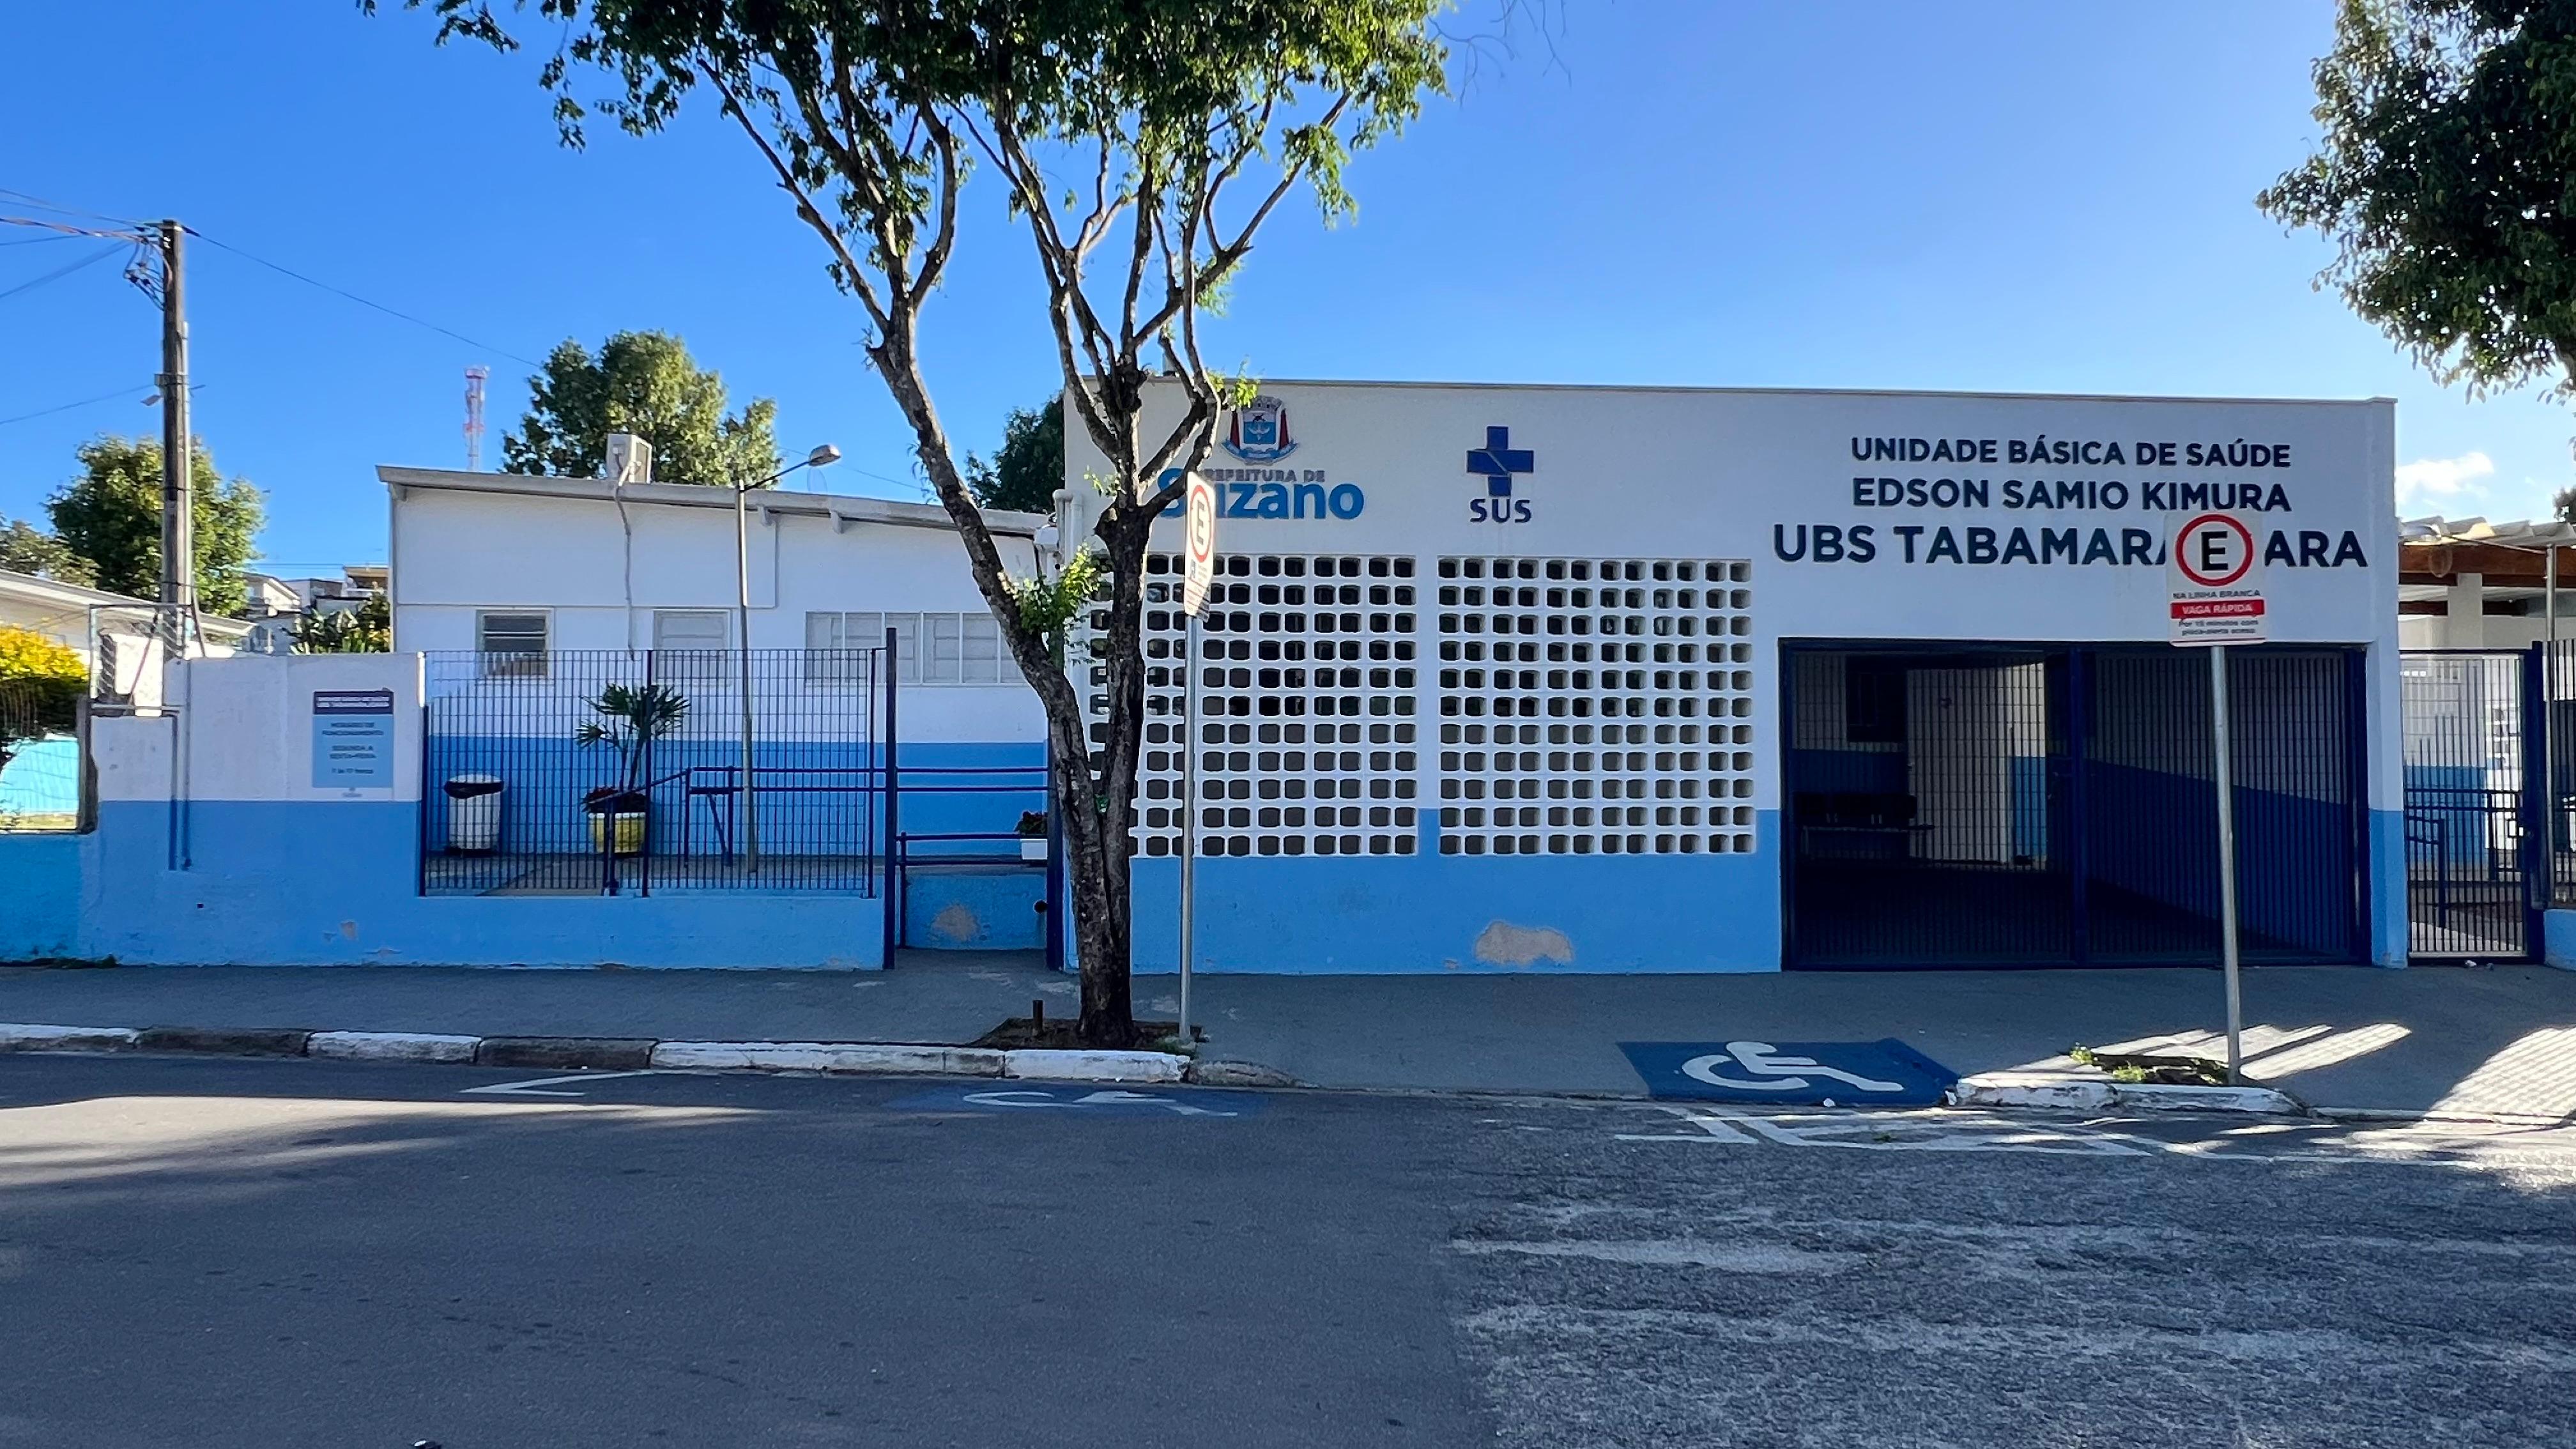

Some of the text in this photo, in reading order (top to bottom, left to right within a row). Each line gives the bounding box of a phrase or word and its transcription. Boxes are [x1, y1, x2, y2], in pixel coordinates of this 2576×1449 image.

[1851, 434, 2292, 469] UNIDADE BÁSICA DE SAÚDE
[1194, 469, 1326, 483] REFEITURA DE
[1469, 498, 1532, 524] SUS
[1853, 477, 2292, 512] EDSON SAMIO KIMURA
[1196, 500, 1205, 546] E
[1774, 524, 1876, 564] UBS
[2201, 531, 2228, 571] E
[2182, 603, 2253, 615] VAGA RÁPIDA
[2220, 589, 2260, 597] BRANCA
